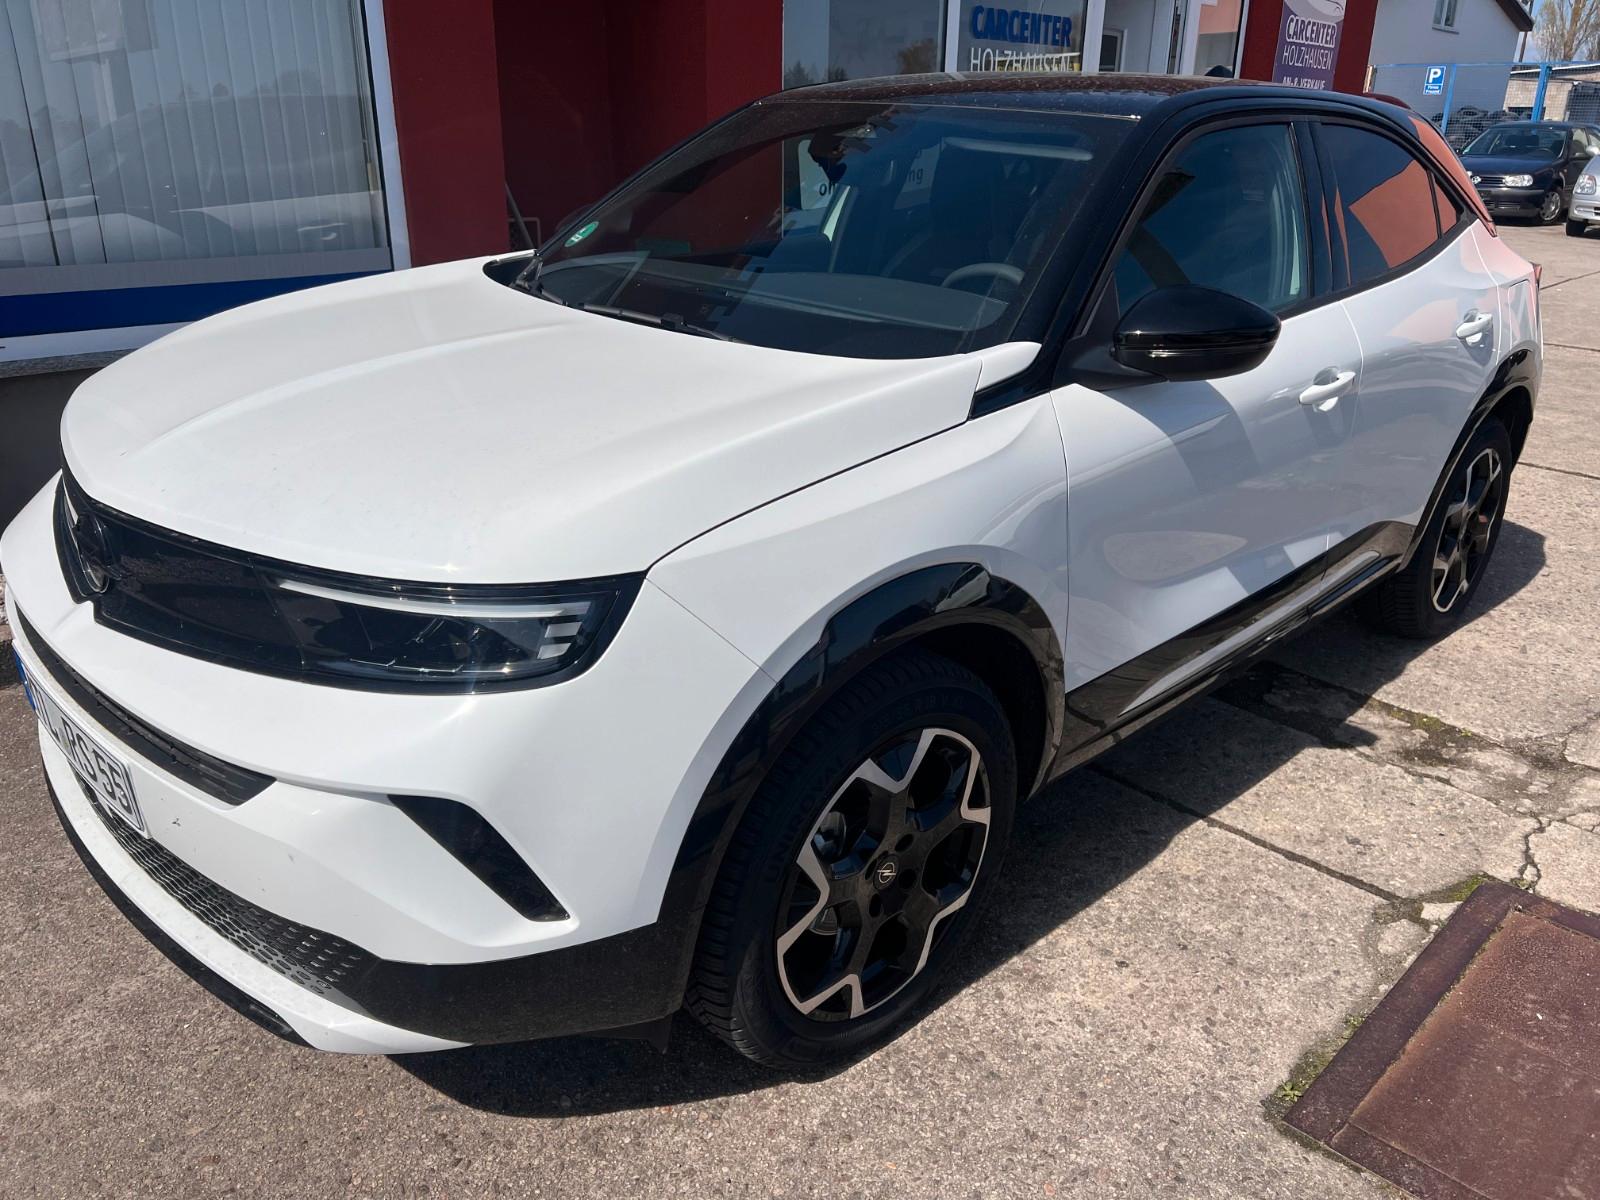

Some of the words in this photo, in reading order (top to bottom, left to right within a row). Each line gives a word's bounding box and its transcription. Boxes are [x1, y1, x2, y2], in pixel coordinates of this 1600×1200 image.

[971, 5, 1072, 47] CARCENTER
[1286, 15, 1337, 48] CARCENTER
[1282, 45, 1334, 70] HOLZHAUSEN
[1428, 68, 1442, 84] P
